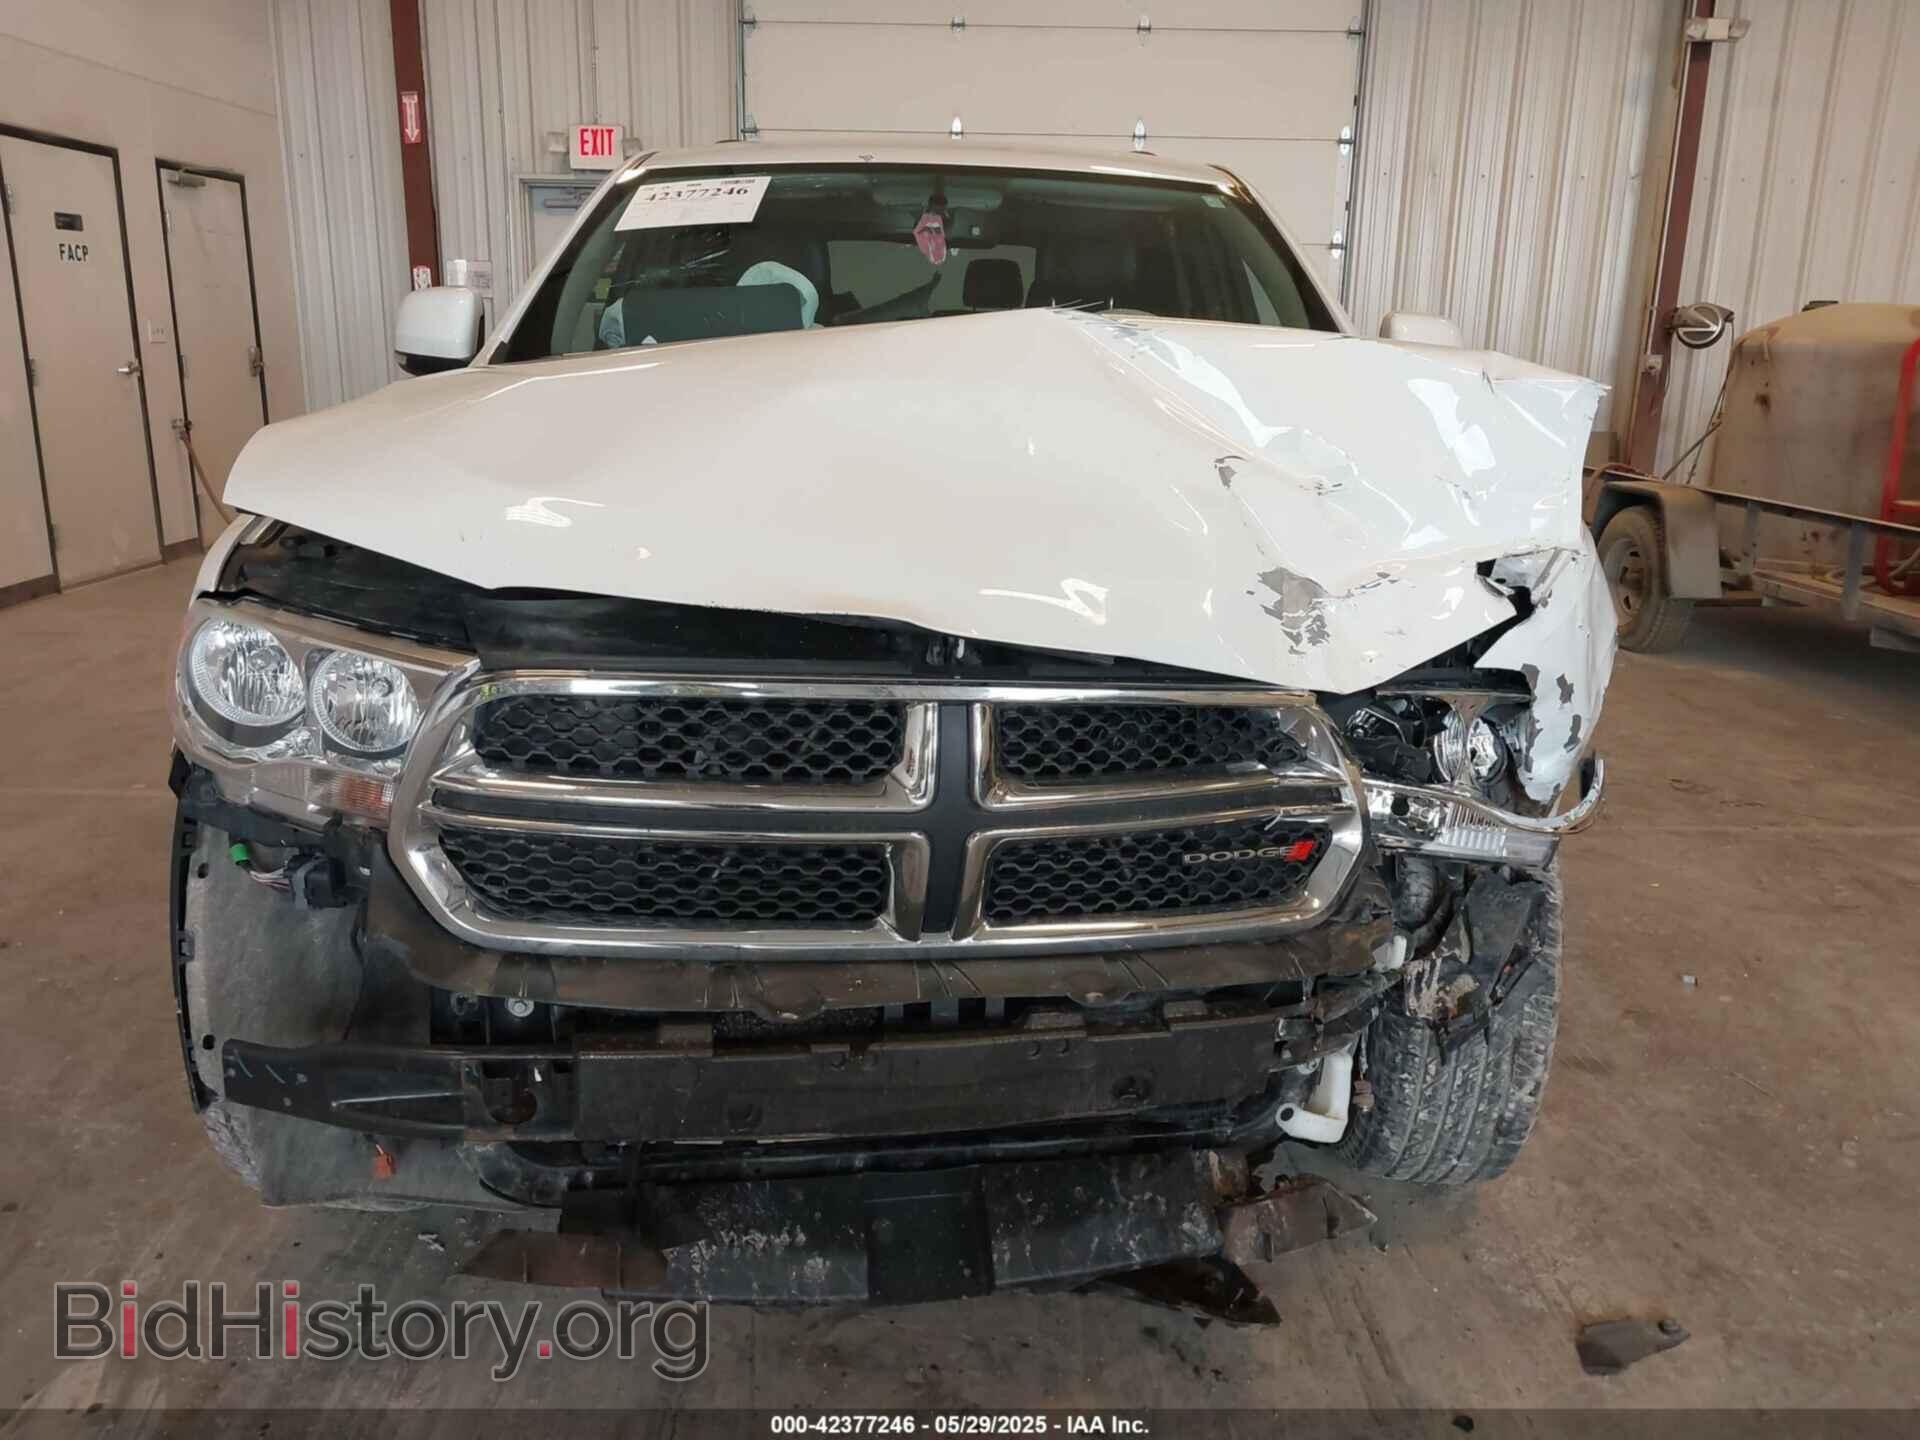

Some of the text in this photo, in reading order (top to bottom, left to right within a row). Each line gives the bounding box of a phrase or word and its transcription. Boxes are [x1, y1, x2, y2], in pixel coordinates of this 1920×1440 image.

[580, 128, 614, 156] EXIT
[645, 186, 748, 202] 42377246
[59, 243, 89, 262] FACP
[1184, 846, 1297, 864] DODGE
